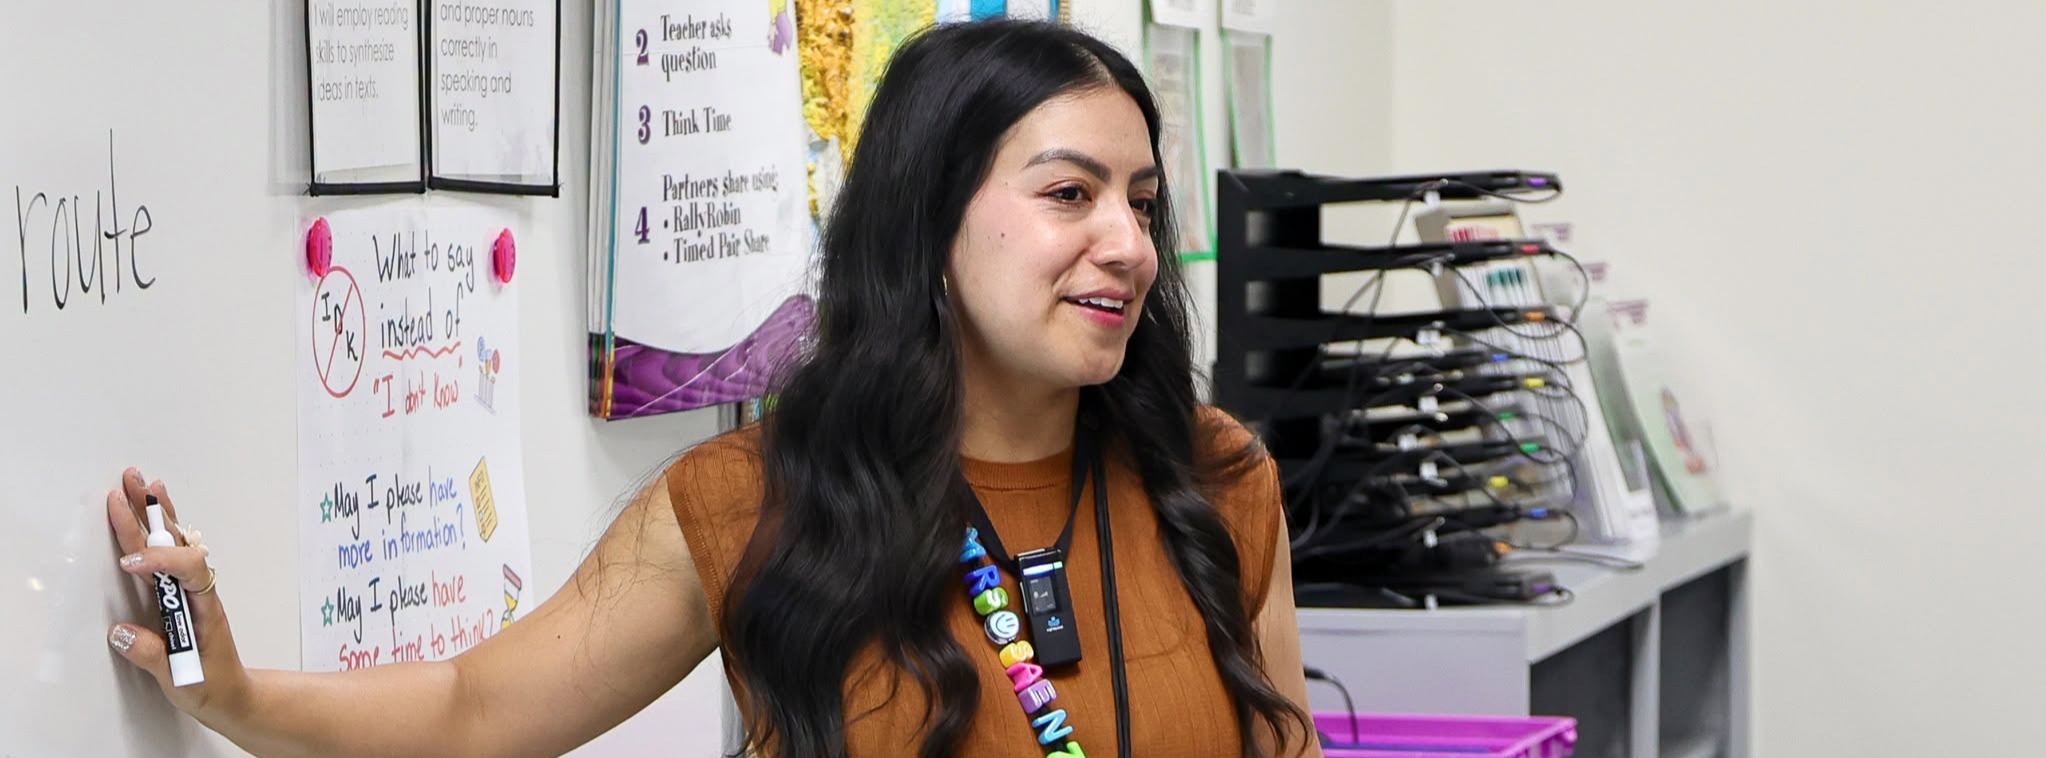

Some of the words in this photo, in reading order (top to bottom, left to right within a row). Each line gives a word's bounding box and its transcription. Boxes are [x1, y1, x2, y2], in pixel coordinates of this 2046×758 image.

[320, 3, 335, 26] will
[337, 3, 373, 30] employ
[374, 2, 409, 31] reading
[440, 0, 461, 22] and
[464, 6, 499, 28] proper
[501, 8, 534, 27] nouns
[316, 40, 335, 64] skills
[337, 40, 347, 63] to
[350, 38, 395, 67] synthesize
[440, 36, 486, 62] correctly
[488, 36, 498, 58] in
[635, 28, 650, 67] 2
[660, 14, 708, 42] Teacher
[709, 12, 733, 40] asks
[661, 46, 717, 82] question
[344, 75, 353, 100] in
[355, 74, 379, 99] texts.
[440, 69, 488, 98] speaking
[490, 72, 512, 93] and
[440, 103, 478, 132] writing.
[638, 104, 652, 146] 3
[662, 108, 700, 137] Think
[703, 106, 732, 134] Time
[662, 173, 719, 202] Partners
[722, 169, 749, 197] share
[15, 128, 156, 315] route
[634, 206, 651, 244] 4
[372, 231, 417, 283] What
[424, 229, 439, 272] to
[447, 242, 475, 293] say
[673, 235, 715, 264] Timed
[718, 231, 742, 259] Pair
[743, 228, 770, 255] Share
[380, 285, 433, 349] instead
[445, 281, 464, 340] of
[334, 481, 361, 541] May
[365, 473, 380, 509] I
[386, 472, 424, 525] please
[428, 464, 458, 508] have
[338, 539, 373, 569] more
[154, 571, 180, 609] XPO
[337, 586, 362, 644] May
[368, 576, 383, 613] I
[389, 575, 428, 627] please
[431, 568, 467, 608] have
[391, 625, 426, 664] time
[430, 622, 446, 659] to
